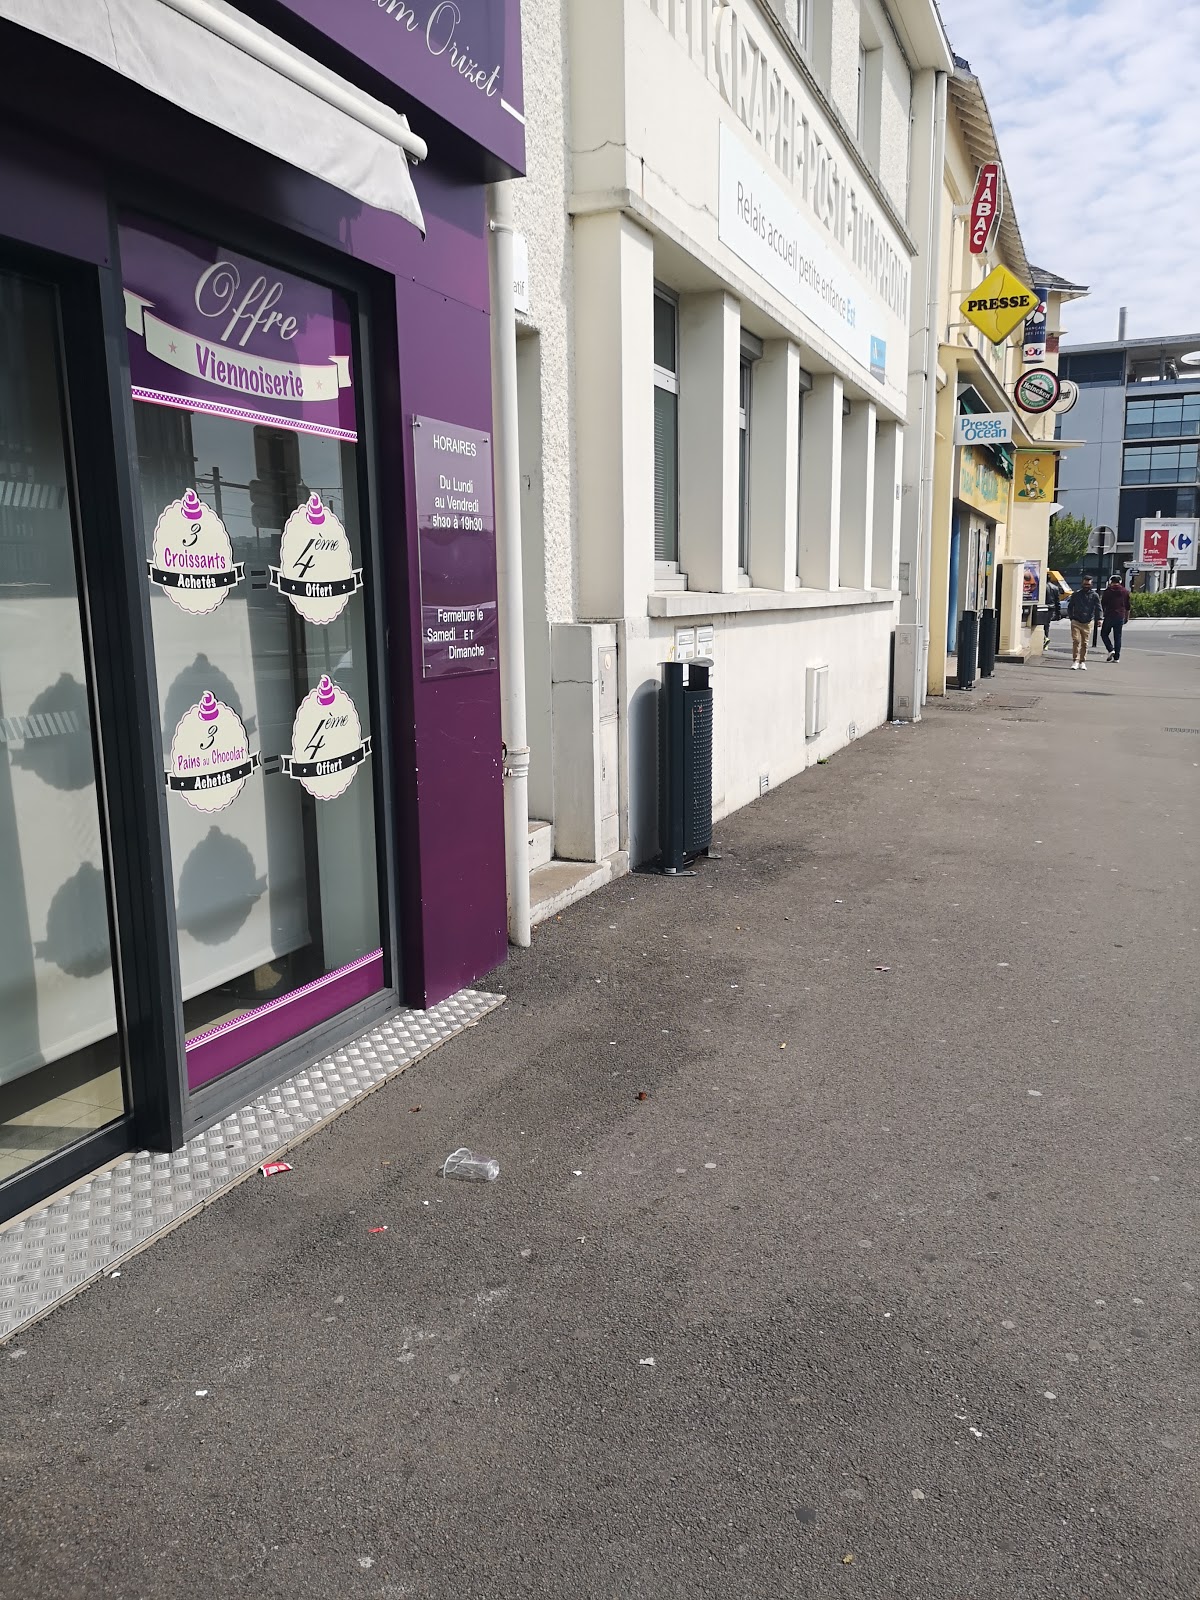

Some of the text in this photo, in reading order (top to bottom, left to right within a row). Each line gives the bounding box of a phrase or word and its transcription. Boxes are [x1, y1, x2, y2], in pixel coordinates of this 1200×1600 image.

[426, 0, 500, 97] Orizet
[973, 173, 995, 246] TABAC
[737, 180, 856, 329] Relais accueil petite enfance Est
[194, 261, 300, 347] Offre
[967, 294, 1030, 312] PRESSE
[195, 342, 304, 397] Viennoiserie
[1022, 380, 1051, 400] Heineken
[961, 418, 1002, 431] Presse
[433, 434, 477, 457] HORAIRES
[439, 474, 474, 494] Du Lundi
[434, 495, 479, 513] au Vendredi
[432, 513, 483, 531] 5h30 à 19h30
[182, 523, 202, 547] 3
[164, 547, 226, 569] Croissants
[177, 573, 217, 588] Achetés
[305, 583, 333, 597] Offert
[437, 608, 484, 623] Fermeture le
[427, 627, 474, 642] Samedi ET
[448, 643, 485, 660] Dimanche
[200, 724, 218, 750] 3
[177, 746, 246, 771] Pains au Chocolat
[316, 758, 343, 776] Offert
[194, 774, 232, 790] Achetés
